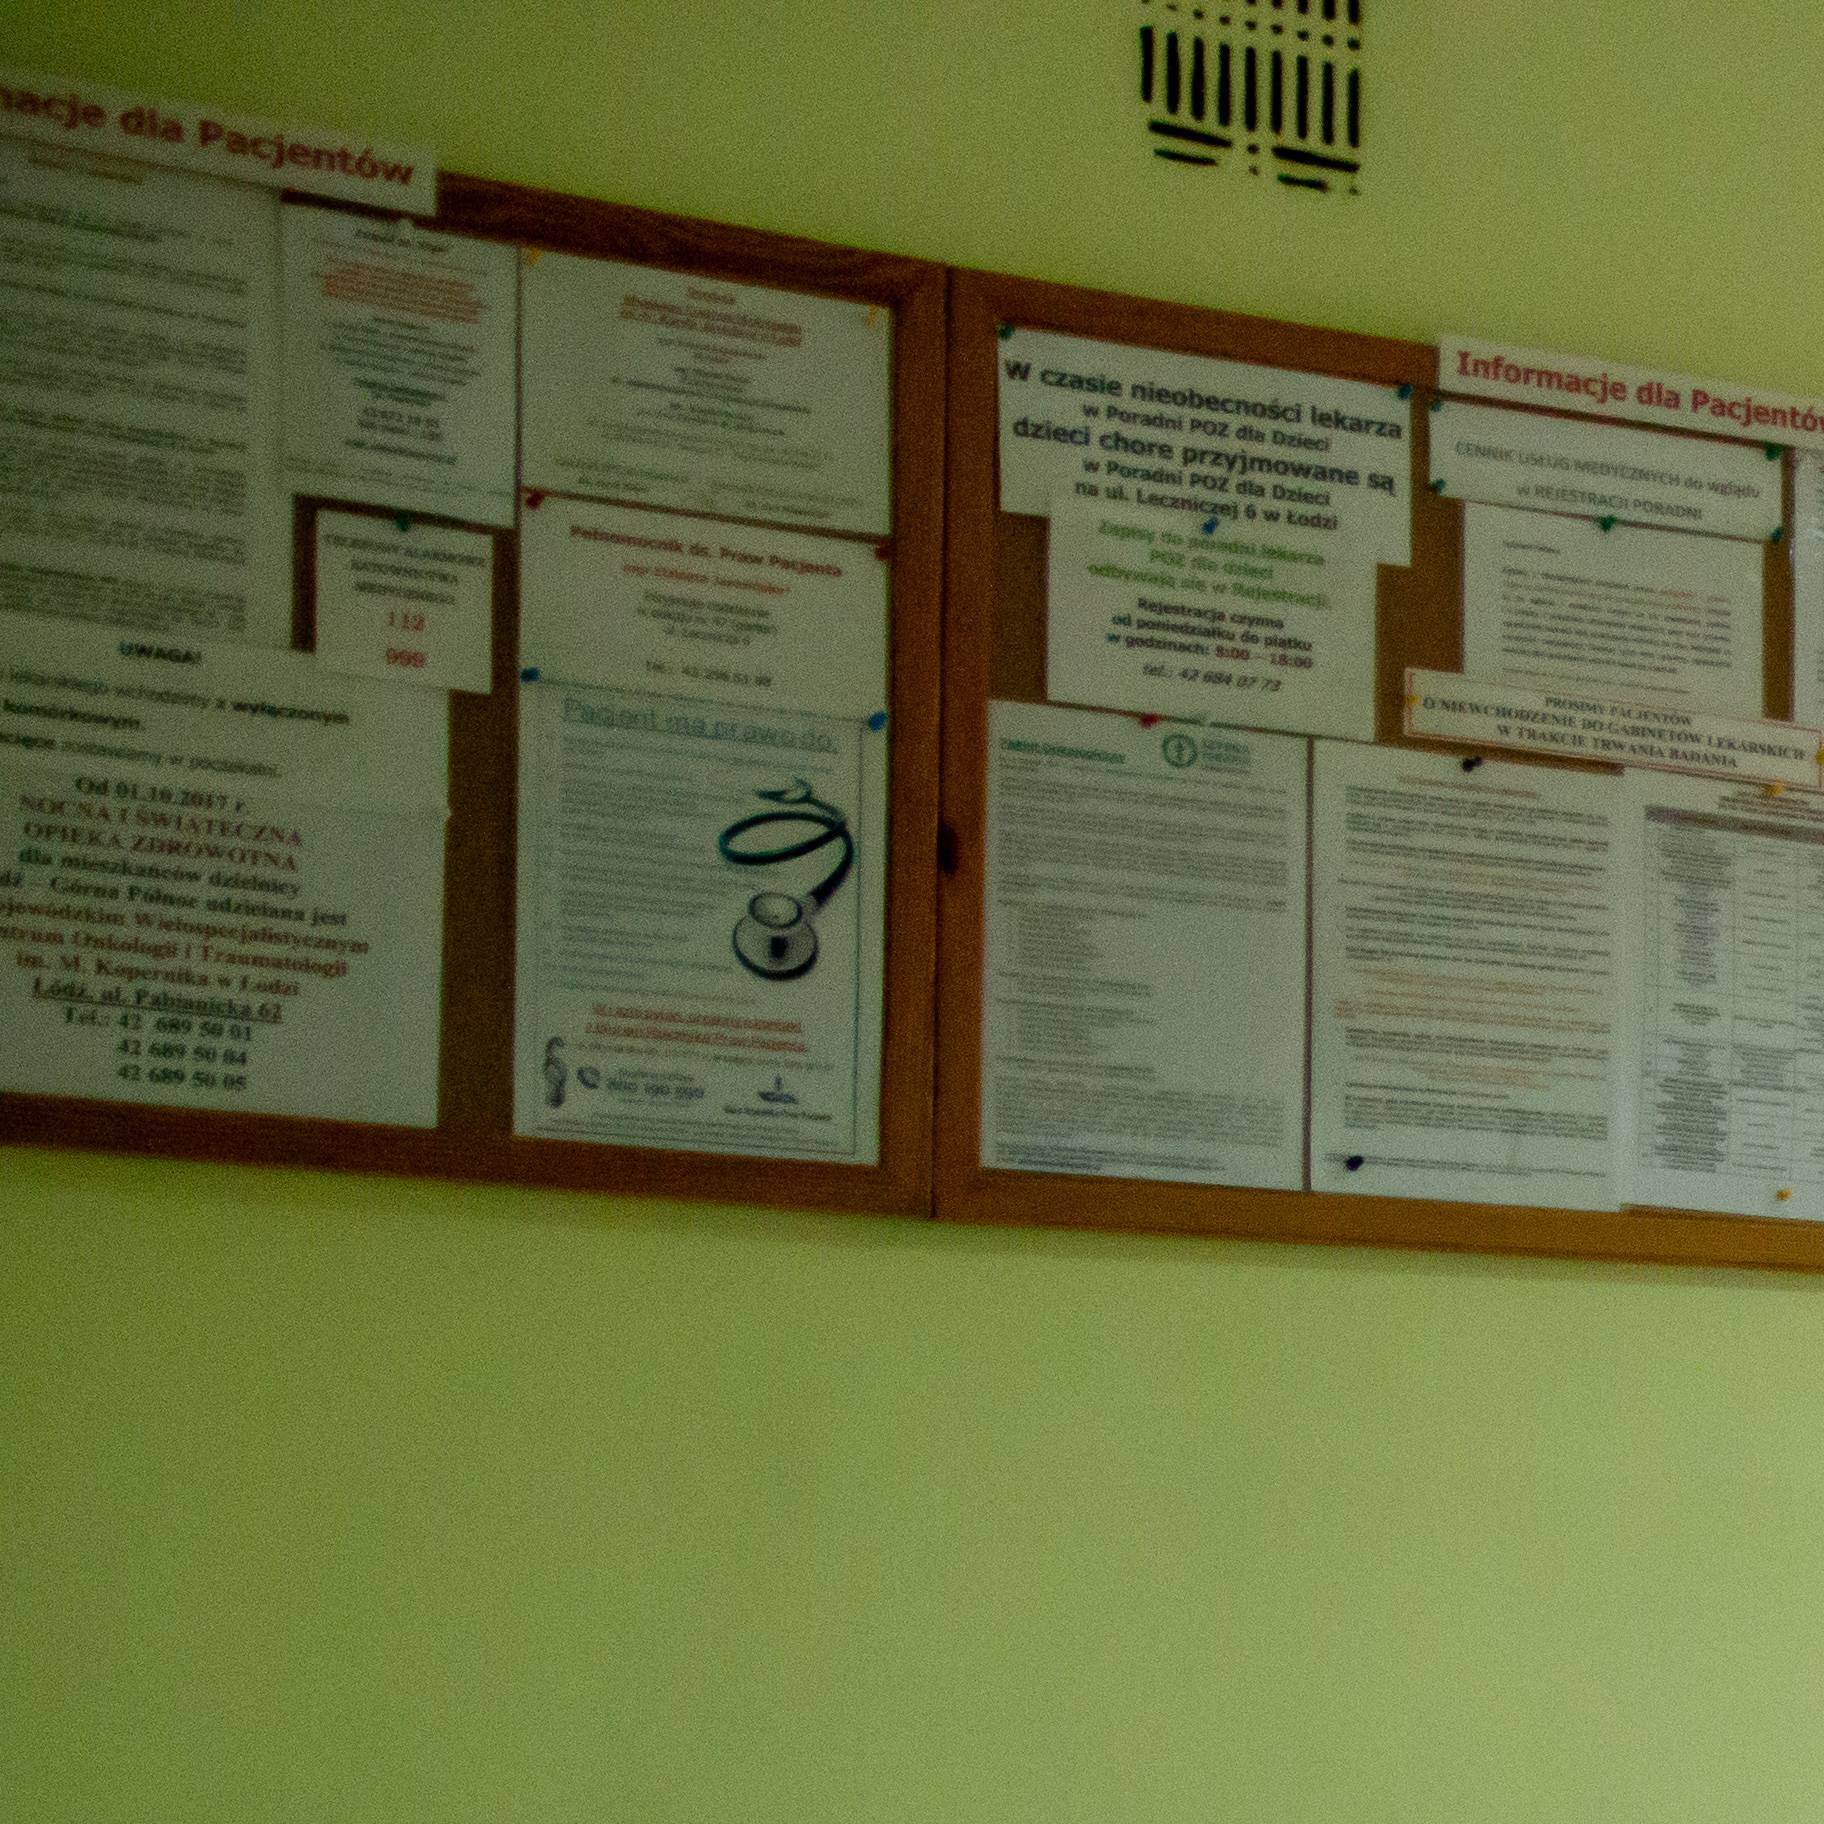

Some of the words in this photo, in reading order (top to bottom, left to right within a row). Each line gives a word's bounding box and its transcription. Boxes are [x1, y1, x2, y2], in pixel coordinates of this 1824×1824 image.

[120, 105, 184, 143] dla
[199, 117, 414, 187] Pacjentów
[1455, 350, 1628, 404] Informacje
[1637, 382, 1682, 411] dla
[1005, 358, 1032, 382] W
[1038, 367, 1123, 398] czasie
[1130, 378, 1302, 426] nieobecności
[1310, 404, 1404, 441] lekarza
[1082, 404, 1100, 418] w
[1106, 405, 1184, 432] Poradni
[1189, 419, 1230, 438] POZ
[1235, 424, 1266, 444] dla
[1271, 430, 1331, 453] Dzieci
[1012, 416, 1091, 447] dzieci
[1098, 430, 1174, 460] chore
[1181, 445, 1361, 489] przyjmowane
[1367, 473, 1398, 498] są
[1455, 441, 1516, 464] CENNIK
[1517, 450, 1571, 472] USŁUG
[1573, 458, 1682, 489] MEDYCZNYCH
[1684, 475, 1706, 491] do
[1082, 459, 1100, 473] w
[1106, 459, 1184, 487] Poradni
[1189, 473, 1230, 494] POZ
[1235, 479, 1266, 499] dla
[1271, 484, 1331, 507] Dzieci
[1074, 481, 1099, 499] na
[1105, 484, 1130, 504] ul.
[1136, 488, 1239, 522] Leczniczej
[1244, 503, 1257, 521] 6
[1263, 507, 1281, 522] w
[1286, 506, 1340, 531] Łodzi
[1534, 484, 1629, 513] REJESTRACJI
[1632, 497, 1703, 521] PORADNI
[769, 552, 844, 579] Pacjenta
[1111, 612, 1133, 628] od
[1136, 617, 1236, 643] poniedziałku
[1240, 628, 1261, 645] do
[1137, 597, 1227, 623] Rejestracja
[118, 639, 203, 665] UWAGA!
[1179, 667, 1200, 683] 42
[562, 696, 659, 733] Pacjent
[1423, 696, 1436, 711] O
[1440, 698, 1576, 728] NIEWCHODZENIE
[1580, 717, 1605, 733] DO
[1607, 720, 1702, 745] GABINETÓW
[1706, 734, 1806, 760] LEKARSKICH
[1545, 696, 1604, 718] PROSIMY
[1609, 704, 1692, 727] PACJENTÓW
[1496, 723, 1512, 739] W
[1517, 725, 1586, 748] TRAKCIE
[1592, 736, 1666, 759] TRWANIA
[75, 775, 109, 797] Od
[20, 794, 112, 823] NOCNA
[23, 820, 123, 850] OPIEKA
[131, 834, 298, 872] ZDROWOTNA
[18, 845, 53, 866] dla
[60, 855, 202, 884] mieszkańców
[208, 867, 301, 901] dzielnicy
[50, 875, 119, 901] Górna
[127, 884, 198, 910] Północ
[204, 897, 306, 923] udzielana
[310, 905, 348, 929] jest
[72, 930, 180, 959] Onkologii
[201, 944, 349, 979] Traumatologii
[95, 957, 210, 988] Kopernika
[238, 974, 300, 998] Łodzi
[134, 988, 254, 1018] Pabianicka
[257, 1002, 283, 1023] 62
[119, 1012, 143, 1032] 42
[154, 1017, 194, 1038] 689
[229, 1025, 253, 1044] 01
[117, 1038, 143, 1058] 42
[148, 1042, 188, 1062] 689
[116, 1064, 143, 1084] 42
[147, 1068, 188, 1087] 689
